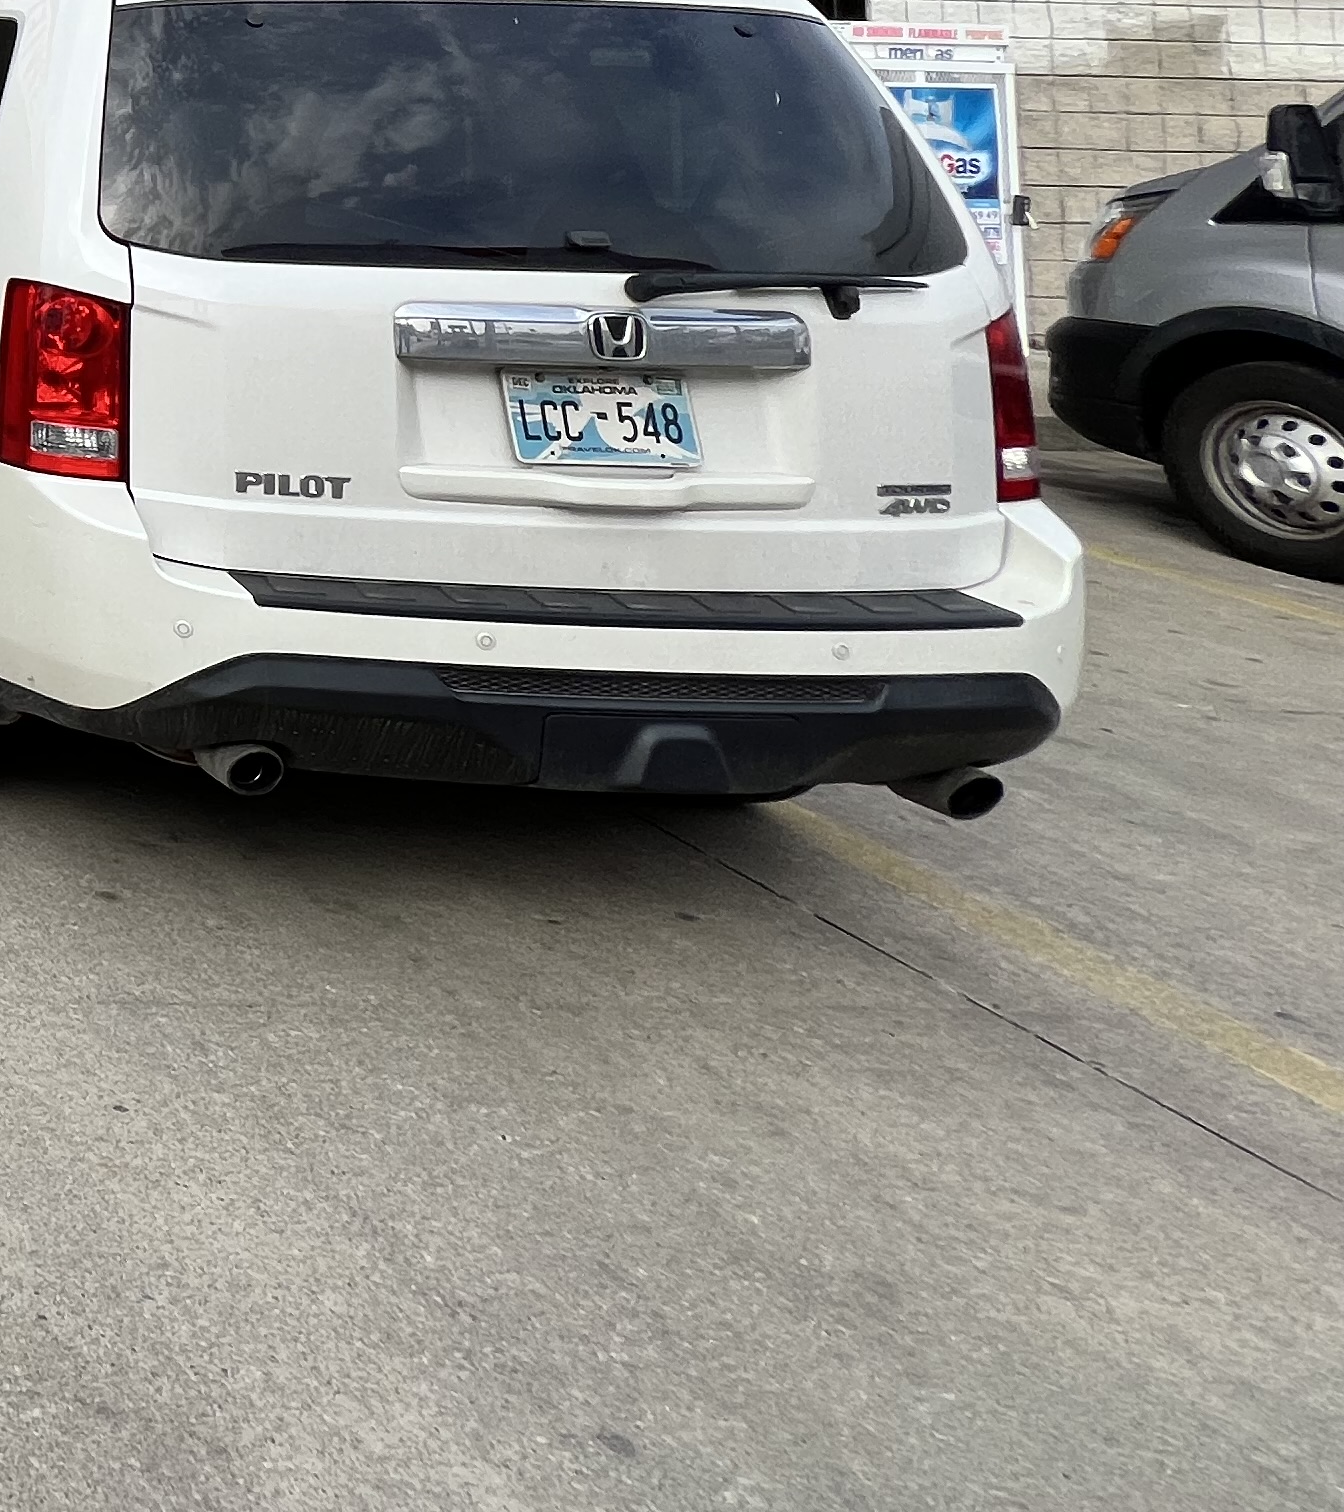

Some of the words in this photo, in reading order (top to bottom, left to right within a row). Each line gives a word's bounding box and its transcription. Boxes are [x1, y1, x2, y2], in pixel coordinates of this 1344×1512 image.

[940, 154, 981, 174] Gas
[552, 385, 638, 396] OKLAHOMA
[567, 377, 620, 385] EXPLORE
[518, 399, 584, 441] LCC
[616, 402, 683, 445] 548
[561, 446, 651, 454] TRAVELOK.COM
[234, 471, 352, 499] PILOT
[879, 498, 951, 517] 4WD
